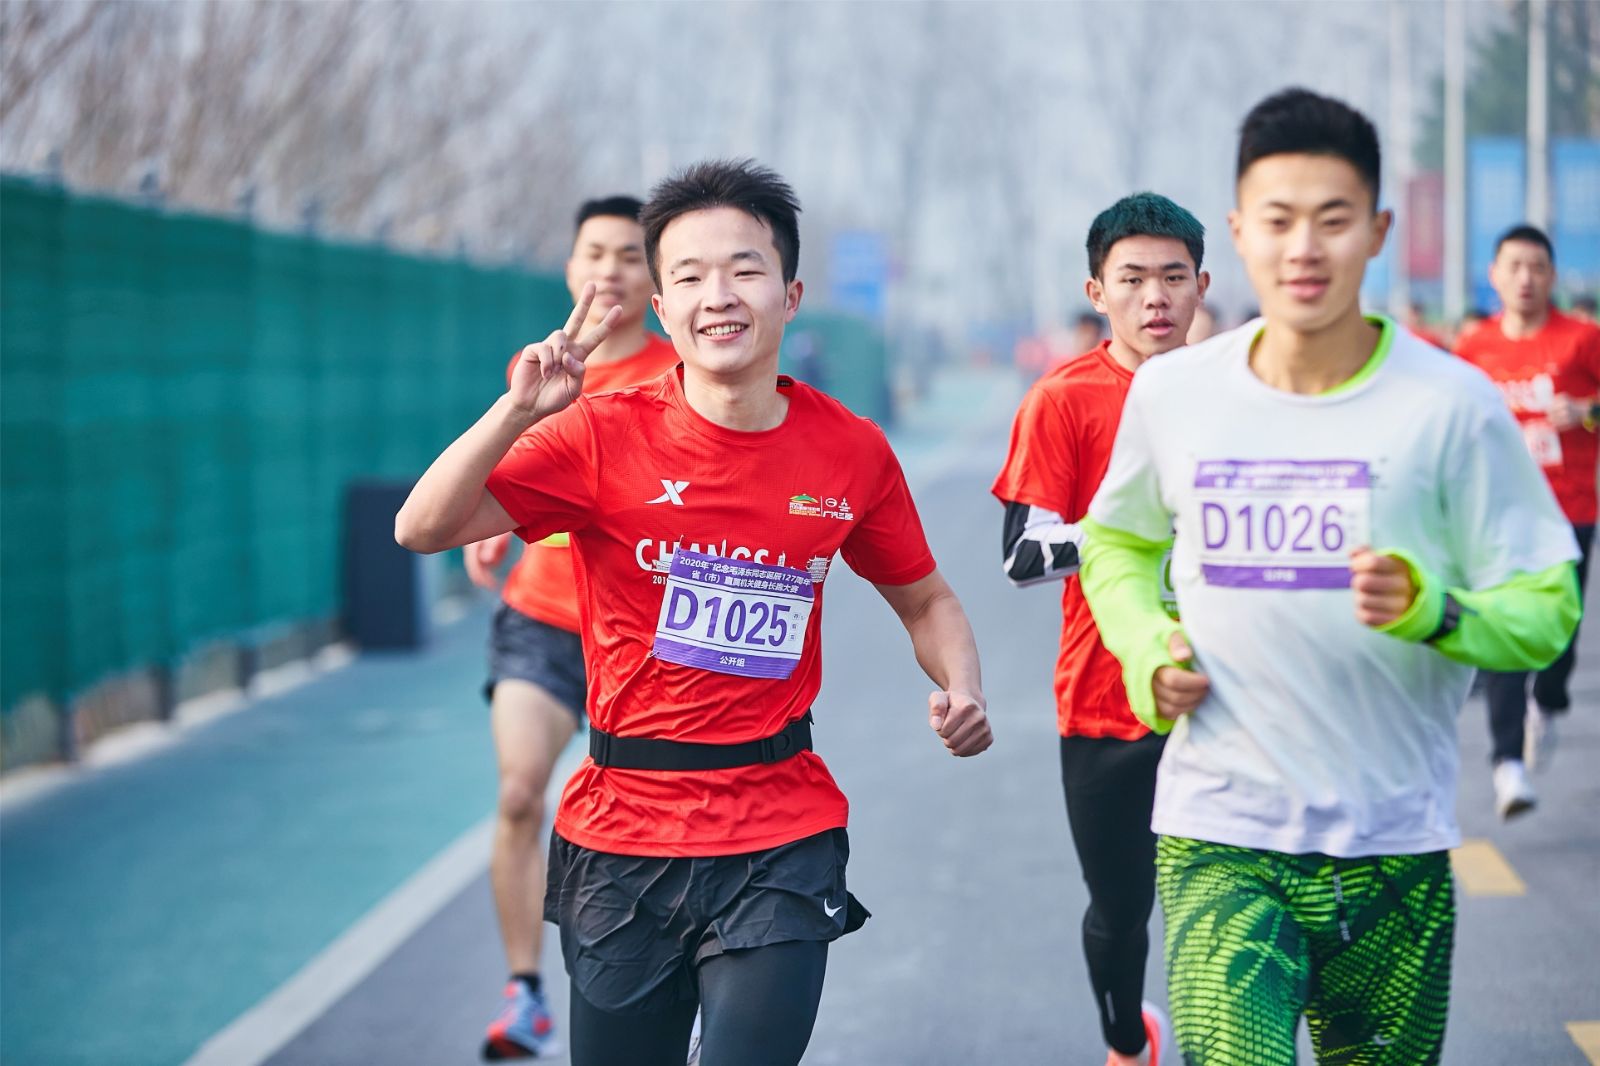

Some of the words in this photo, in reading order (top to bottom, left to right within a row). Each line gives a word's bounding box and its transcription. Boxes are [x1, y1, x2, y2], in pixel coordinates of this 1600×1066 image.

[1202, 502, 1344, 552] D1026
[653, 575, 668, 586] 201
[665, 586, 791, 647] D1025
[719, 655, 746, 668] 公开组
